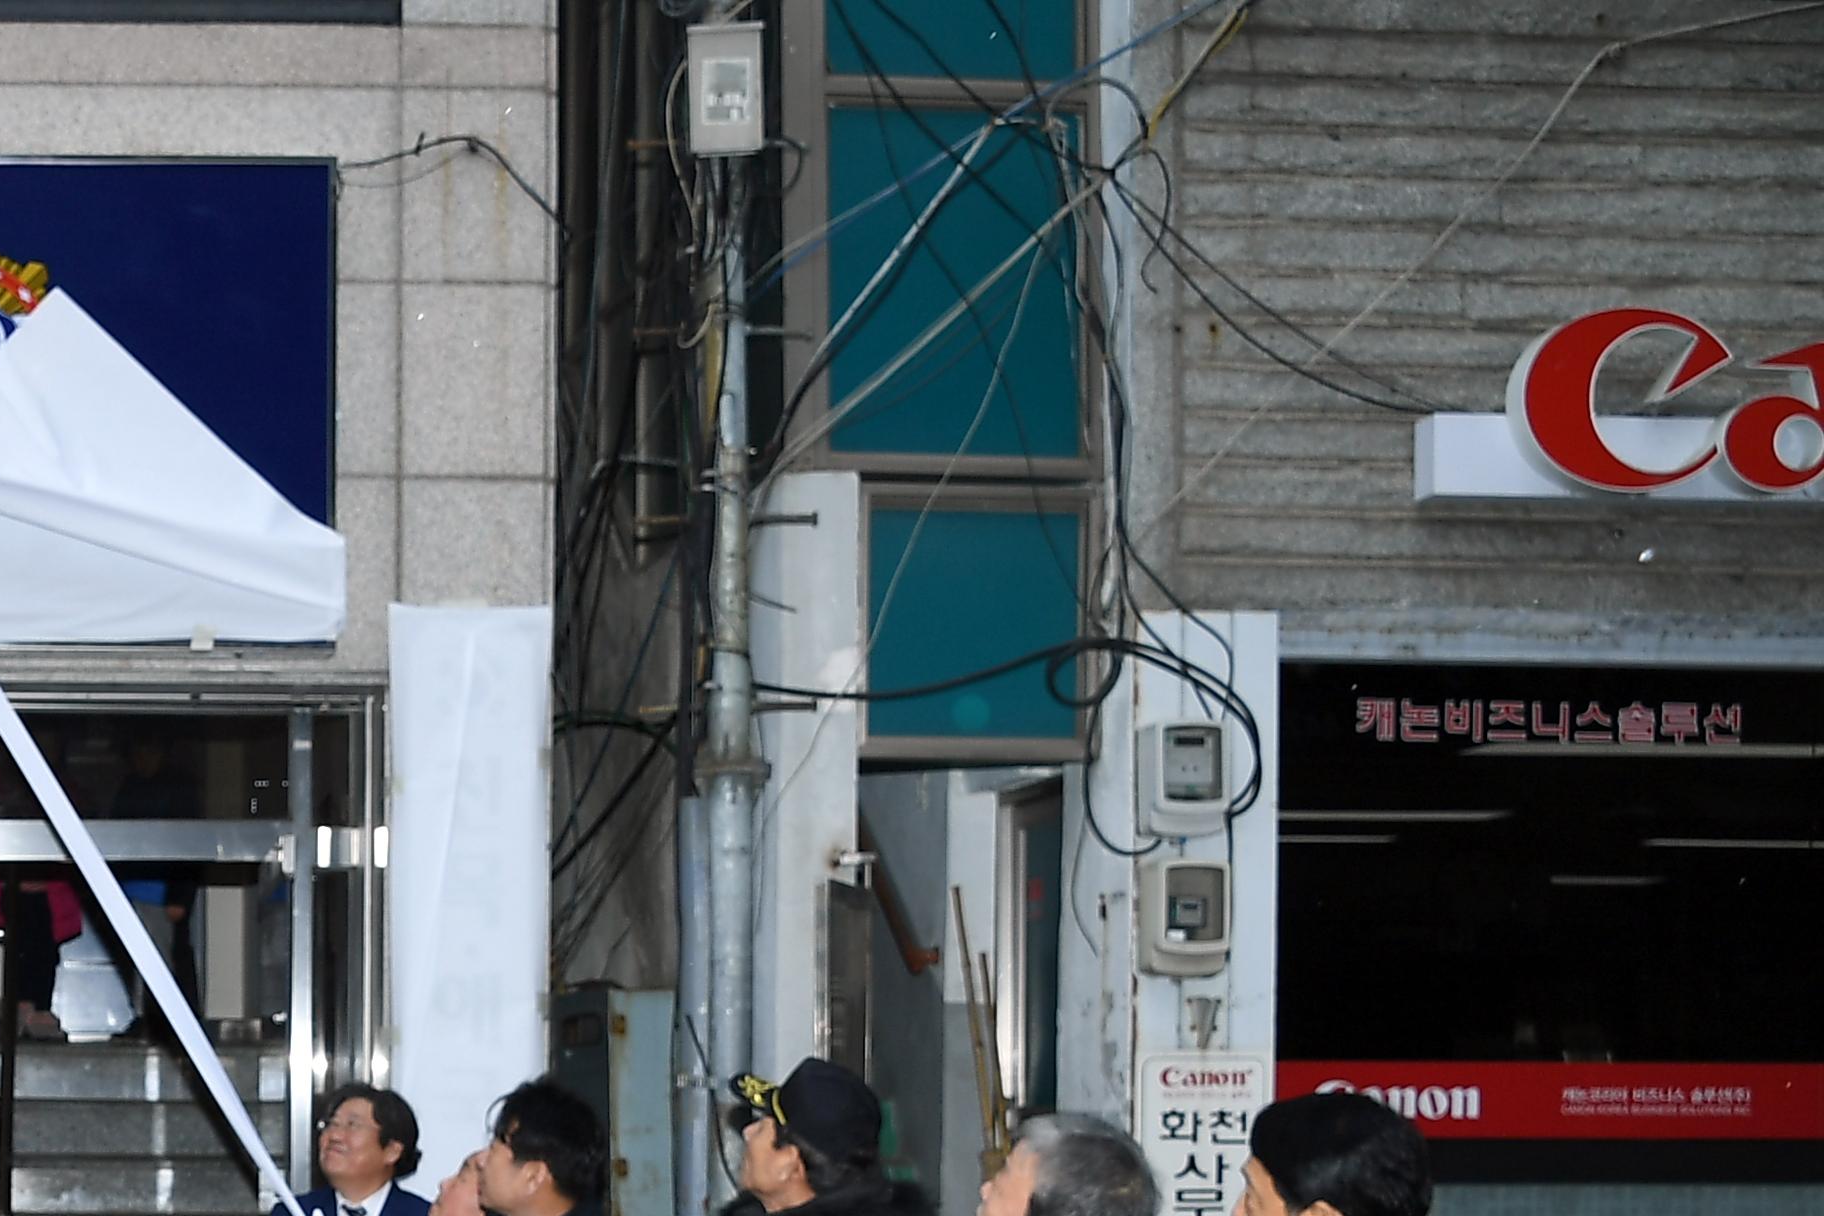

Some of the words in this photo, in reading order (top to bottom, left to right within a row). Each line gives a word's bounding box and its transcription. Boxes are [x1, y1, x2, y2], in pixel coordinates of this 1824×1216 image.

[1355, 696, 1743, 746] 캐논비즈니스솔루션
[1158, 1066, 1254, 1089] Canon
[1159, 1110, 1247, 1145] 화천
